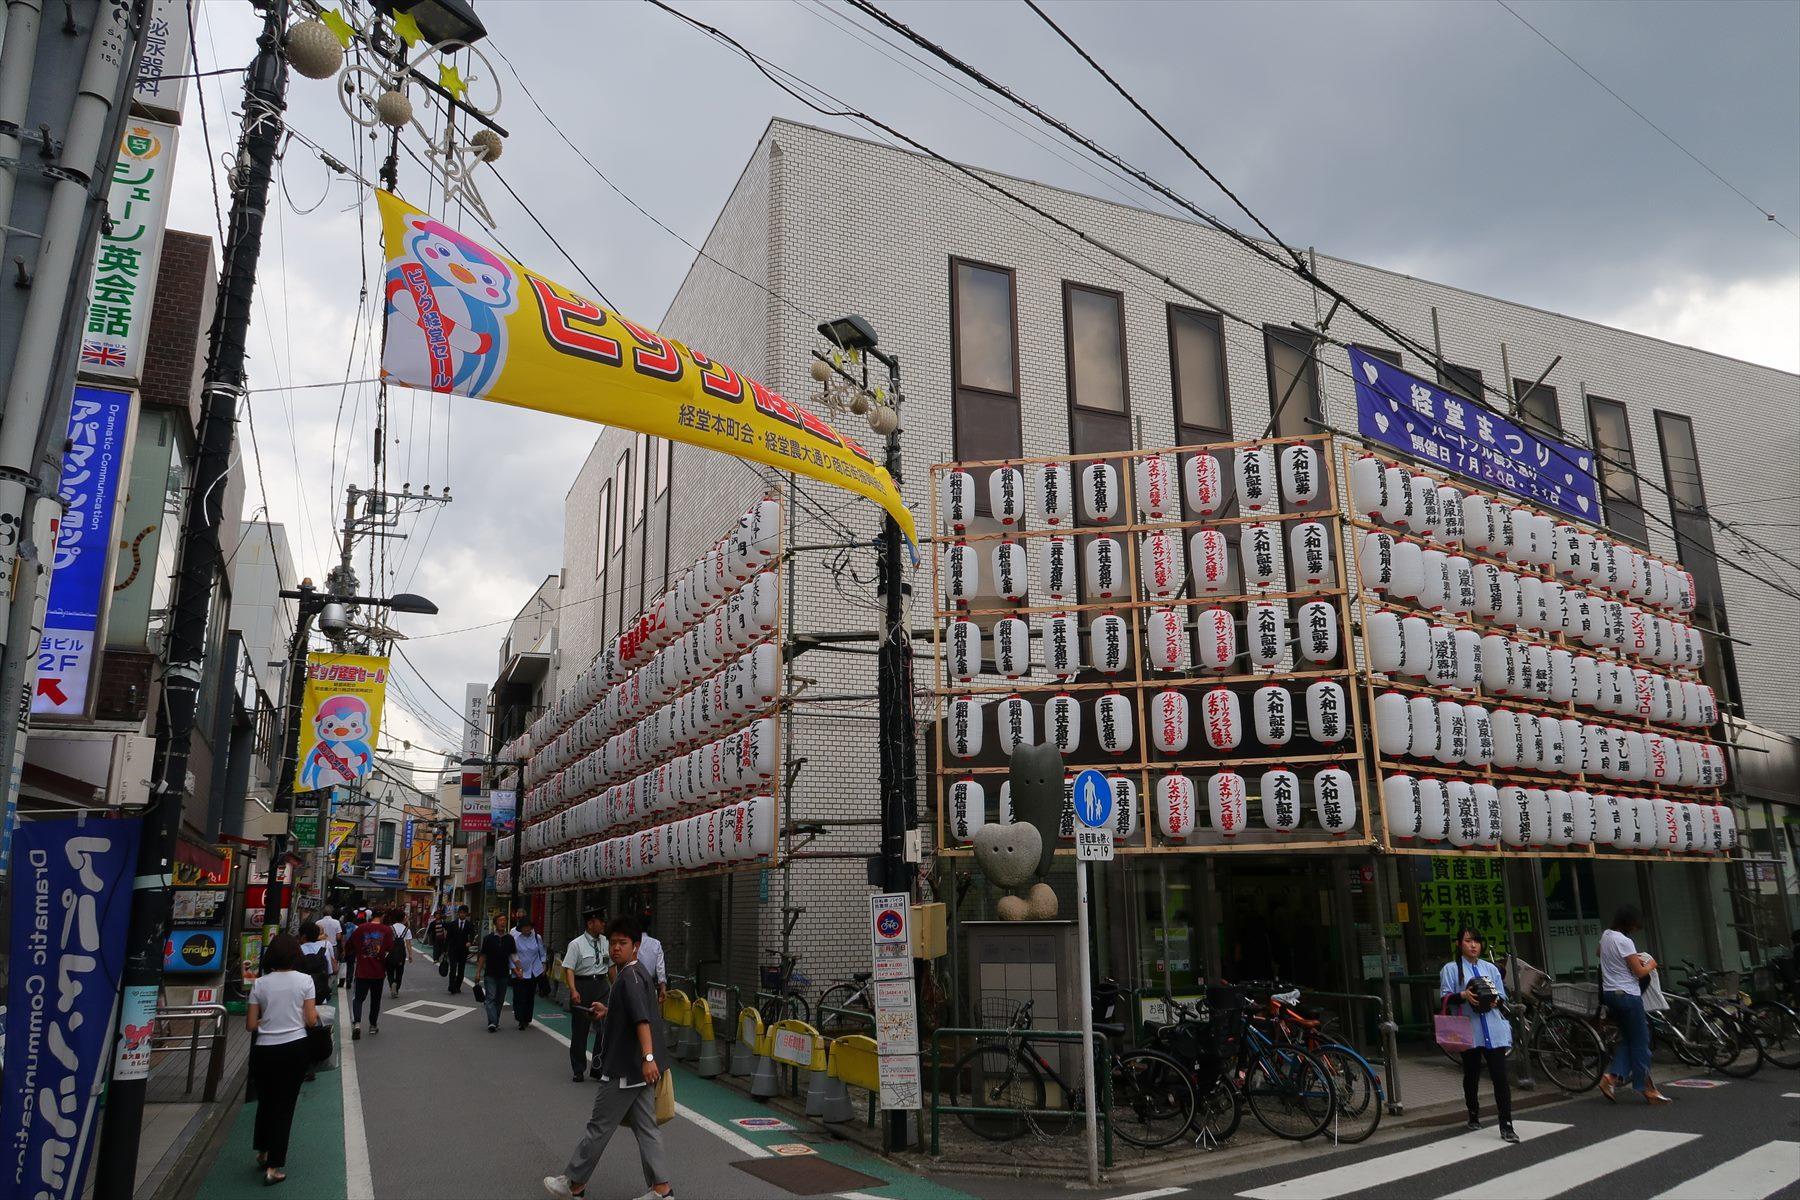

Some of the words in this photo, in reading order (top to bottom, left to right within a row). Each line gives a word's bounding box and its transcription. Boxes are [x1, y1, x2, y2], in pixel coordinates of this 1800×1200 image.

[88, 162, 155, 338] シェーン英会話
[407, 268, 452, 387] ビッグ経堂セール
[104, 404, 121, 451] Dramatic
[1410, 383, 1550, 468] 経堂まつり
[1410, 433, 1451, 464] 開催日
[90, 454, 112, 531] Communication
[1045, 466, 1058, 515] 三井住友銀行
[1093, 464, 1107, 513] 三井住友銀行
[1147, 460, 1161, 508] ルネサンス経堂
[1196, 455, 1210, 504] ルネサンス経堂
[1243, 452, 1262, 499] 大和証券
[1292, 448, 1311, 495] 大和証券
[1422, 488, 1436, 526] 泌尿器科
[1443, 500, 1457, 537] 泌尿器科
[1050, 542, 1064, 591] 三井住友銀行
[1098, 540, 1112, 589] 三井住友銀行
[1151, 536, 1167, 588] ルネサンス経堂
[1203, 531, 1218, 582] ルネサンス経堂
[1253, 529, 1273, 577] 大和証券
[1304, 525, 1323, 574] 大和証券
[1378, 534, 1391, 584] 城南信用金庫
[1458, 569, 1473, 606] 泌尿器科
[1486, 565, 1502, 611] みずほ銀行
[1556, 586, 1569, 627] アスナロ
[1053, 619, 1068, 670] 三井住友銀行
[1105, 617, 1119, 669] 三井住友銀行
[1163, 611, 1178, 663] ルネサンス経堂
[1213, 610, 1229, 662] ルネサンス経堂
[1258, 609, 1278, 659] 大和証券
[1309, 604, 1329, 654] 大和証券
[1609, 604, 1625, 644] 経堂本町会
[1630, 612, 1645, 648] マシュマロ
[37, 654, 79, 671] 2F
[1435, 641, 1450, 679] 泌尿器科
[1162, 693, 1176, 746] ルネサンス経堂
[1208, 693, 1224, 746] ルネサンス経堂
[1267, 690, 1286, 740] 大和証券
[1319, 686, 1338, 737] 大和証券
[1637, 676, 1651, 714] マシュマロ
[1009, 700, 1023, 749] 昭和信用金
[1055, 699, 1069, 749] 三井住友銀行
[1100, 697, 1117, 749] 三井住友銀行
[1452, 717, 1463, 757] 泌尿器科
[1477, 719, 1491, 758] 泌尿器科
[1116, 781, 1130, 835] 三井住友銀行
[1167, 778, 1182, 834] ルネサンス経堂
[1218, 775, 1234, 831] ルネサンス経堂
[1274, 775, 1294, 827] 大和証券
[1320, 775, 1343, 828] 大和証券
[1457, 798, 1475, 839] 泌尿器科
[1488, 800, 1500, 840] 泌尿器科
[1515, 791, 1531, 843] みずほ銀行
[1665, 806, 1678, 843] マシュマロ
[1079, 833, 1110, 844] 自転車を除く
[1433, 858, 1501, 880] 資産運用
[1419, 882, 1505, 906] 休日相談会
